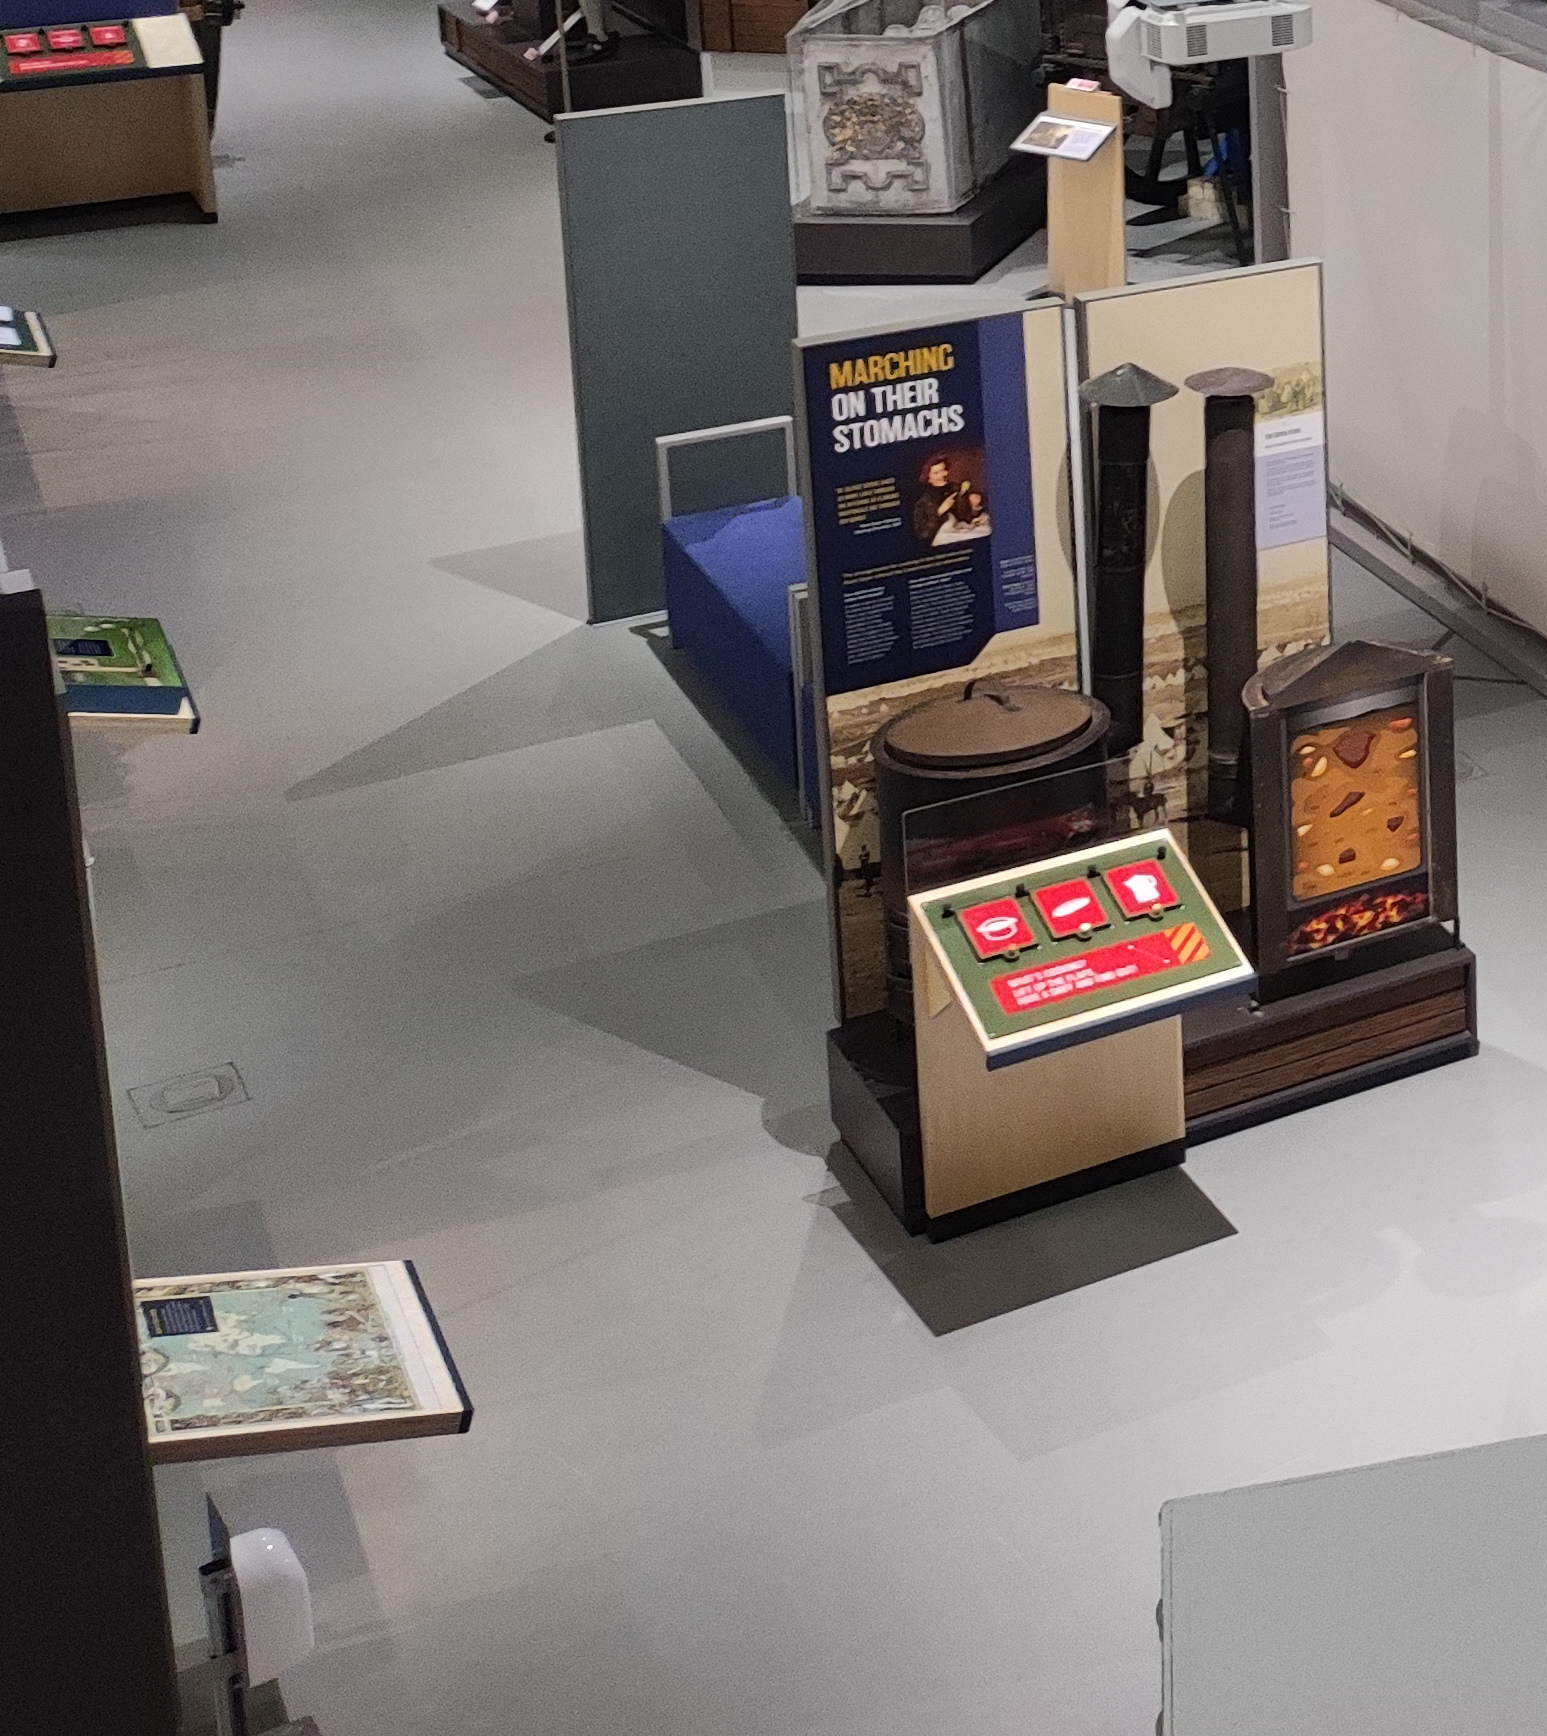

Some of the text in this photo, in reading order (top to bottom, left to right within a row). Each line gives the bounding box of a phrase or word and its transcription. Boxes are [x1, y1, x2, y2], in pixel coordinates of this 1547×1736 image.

[828, 342, 955, 391] MARCHING
[831, 377, 940, 422] ON THEIR
[832, 404, 966, 453] STOMACHS
